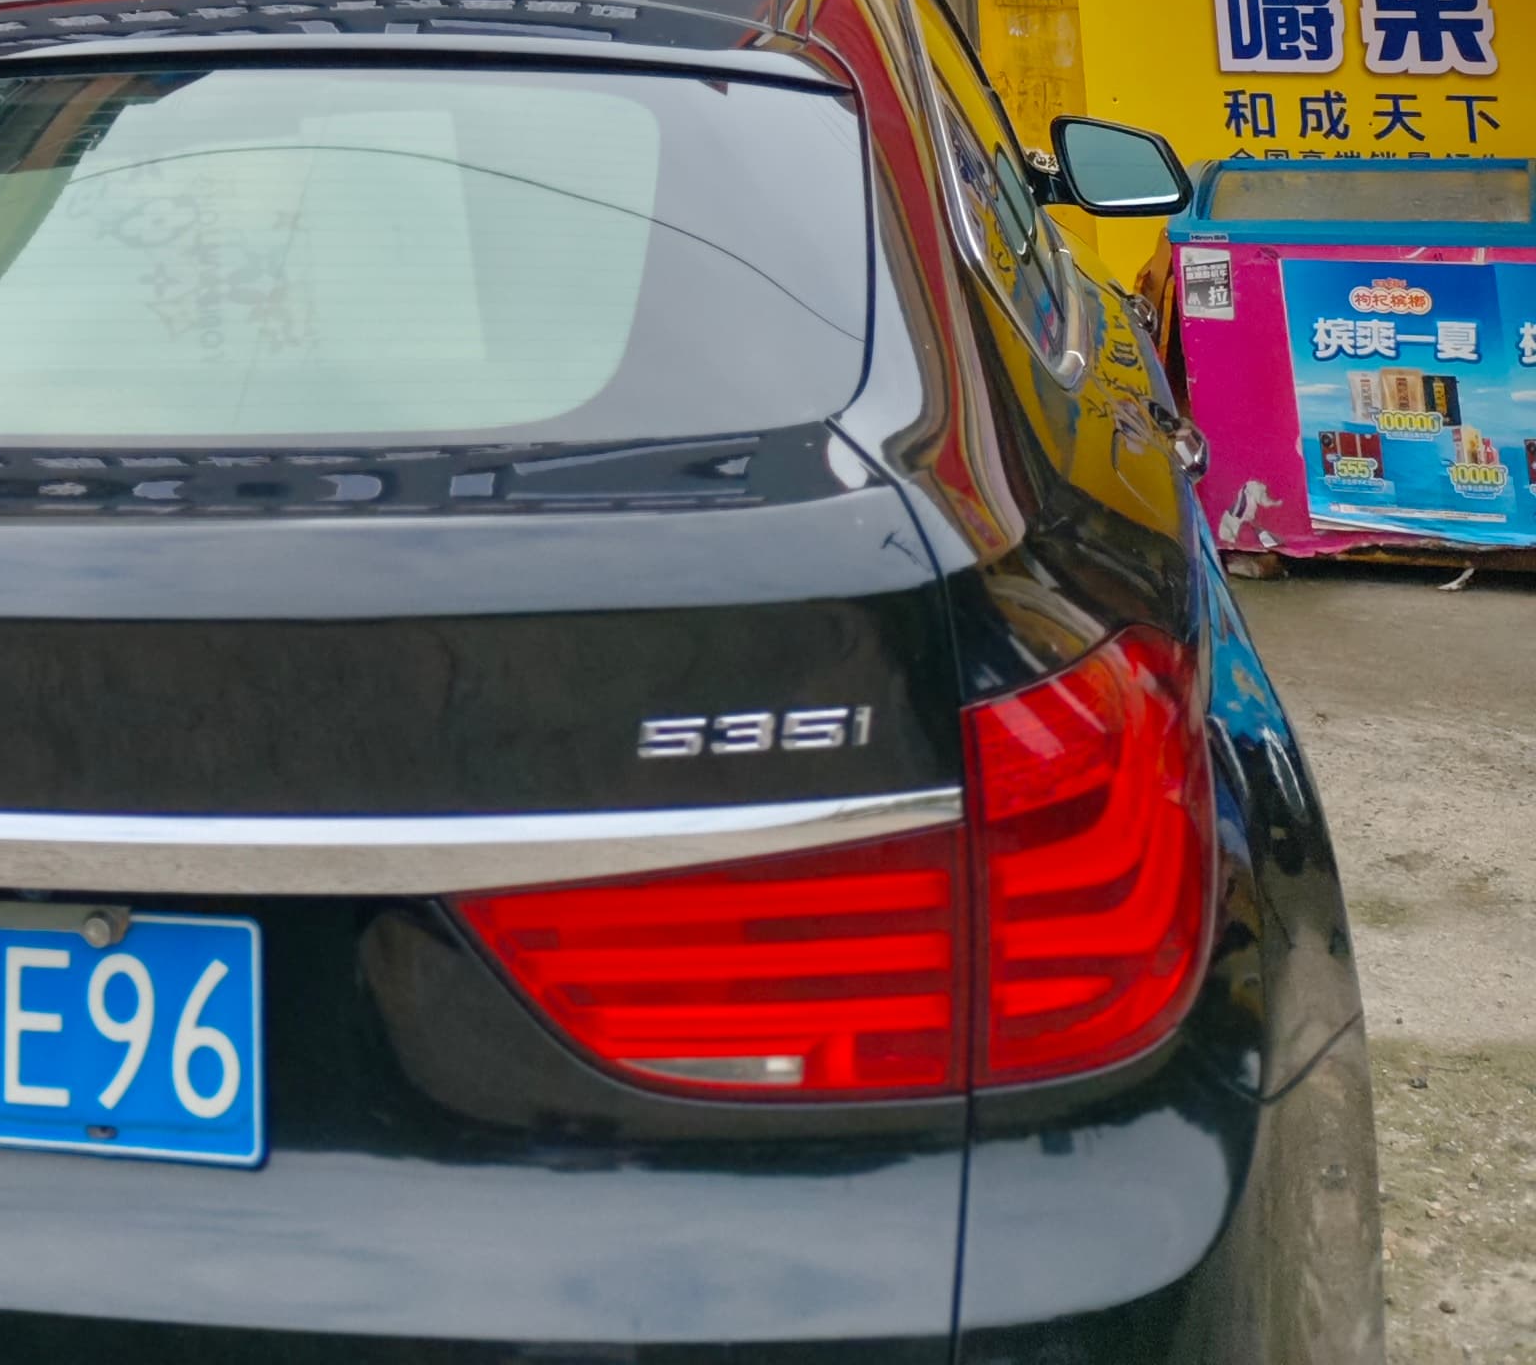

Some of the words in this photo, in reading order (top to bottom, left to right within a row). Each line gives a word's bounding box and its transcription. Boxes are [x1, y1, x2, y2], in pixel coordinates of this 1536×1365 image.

[1223, 89, 1501, 143] 和成天下
[1313, 318, 1479, 360] 槟爽一夏
[637, 706, 872, 758] 535i
